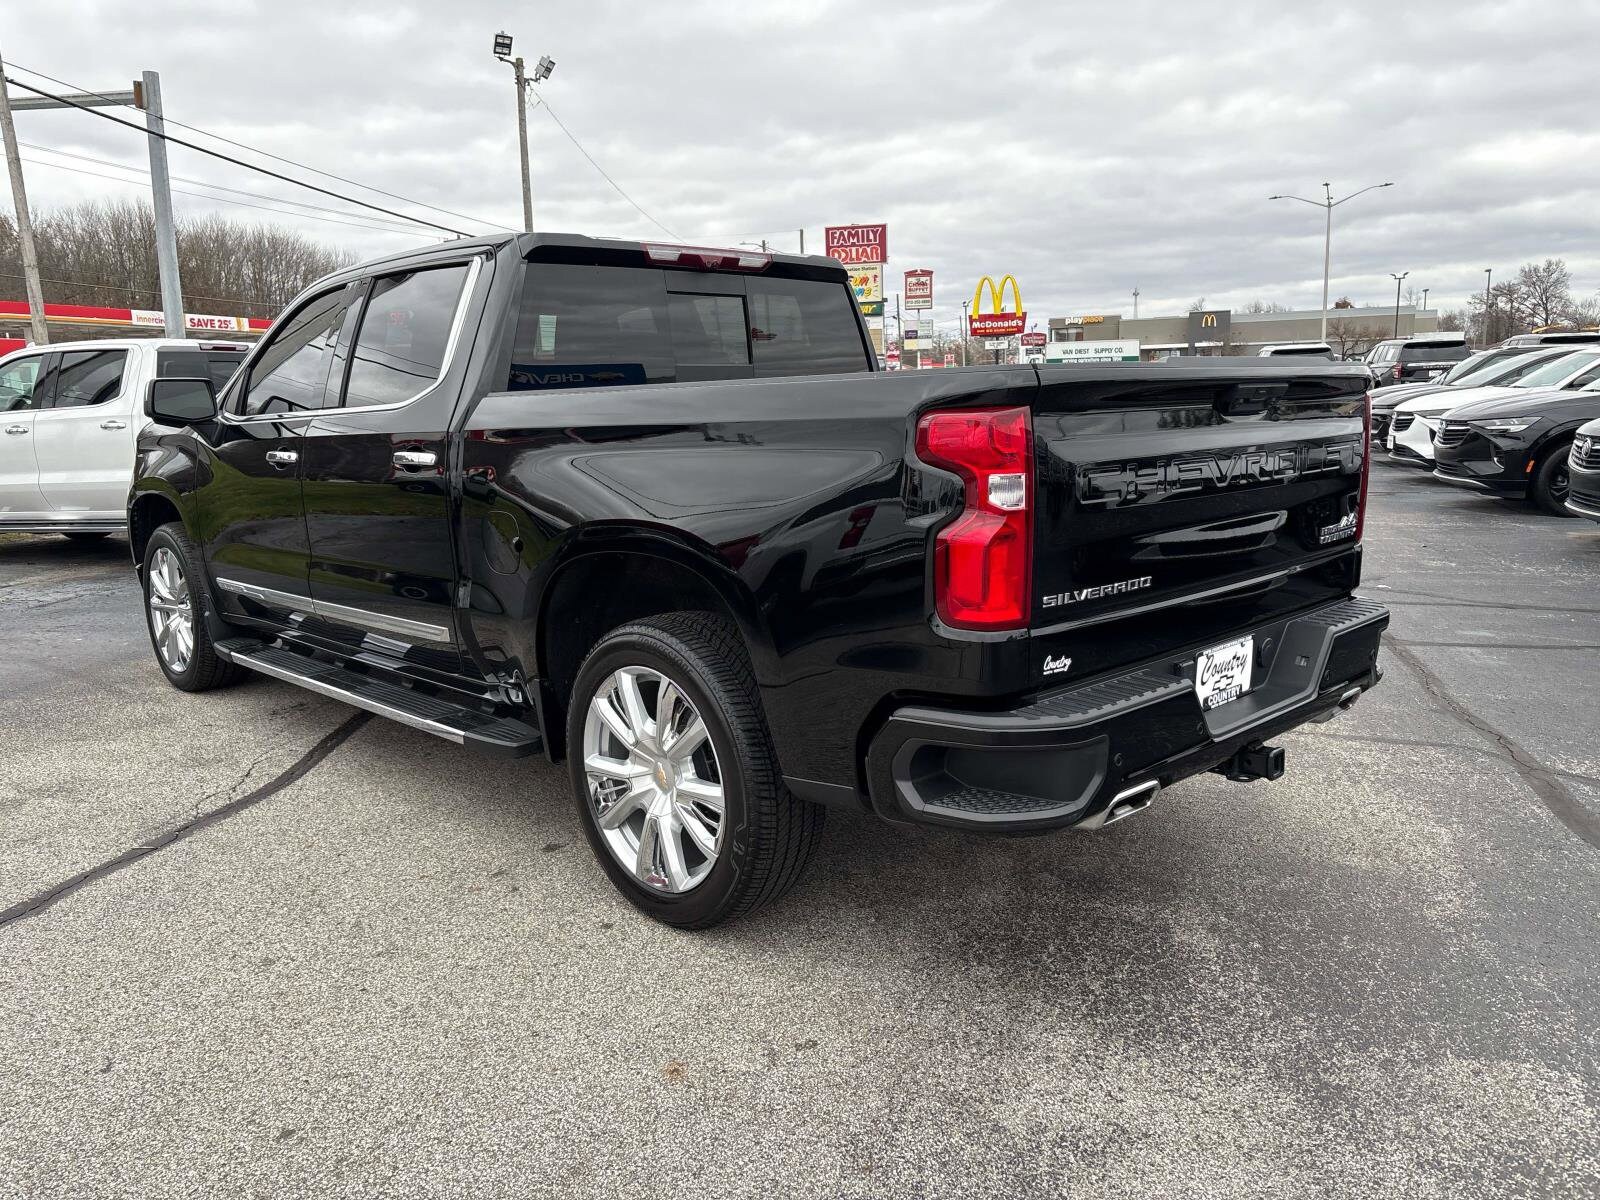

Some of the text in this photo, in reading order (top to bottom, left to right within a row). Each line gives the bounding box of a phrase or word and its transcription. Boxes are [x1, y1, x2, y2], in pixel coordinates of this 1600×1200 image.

[829, 228, 882, 246] FAMILY
[830, 245, 880, 263] DOLLAR
[189, 318, 215, 328] SAVE
[972, 319, 1023, 329] McDonald's
[1076, 441, 1362, 504] CHEVROLET
[1042, 576, 1152, 608] SILVERADO
[1200, 651, 1248, 686] Country
[1207, 686, 1241, 706] COUNTRY
